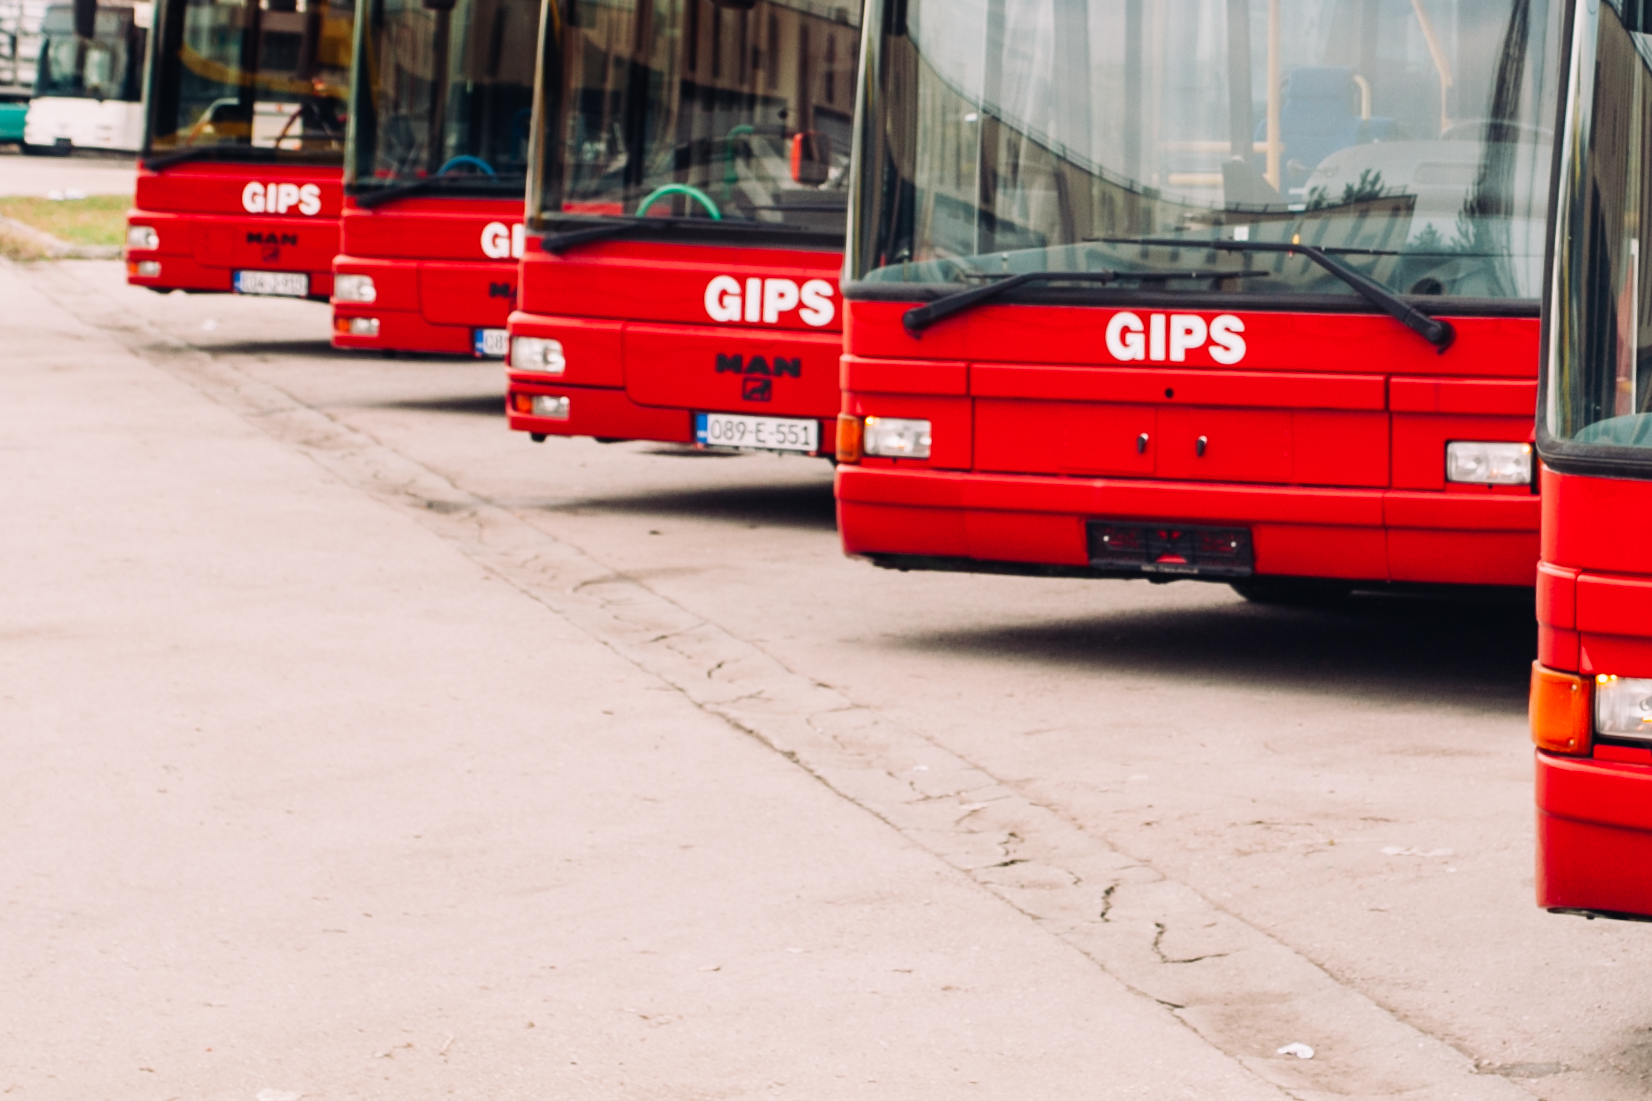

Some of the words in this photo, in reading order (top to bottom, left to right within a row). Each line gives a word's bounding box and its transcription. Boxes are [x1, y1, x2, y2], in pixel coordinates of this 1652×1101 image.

[242, 181, 322, 216] GIPS
[246, 231, 298, 246] MAN
[704, 275, 835, 327] GIPS
[1105, 311, 1247, 365] GIPS
[715, 353, 802, 377] MAN
